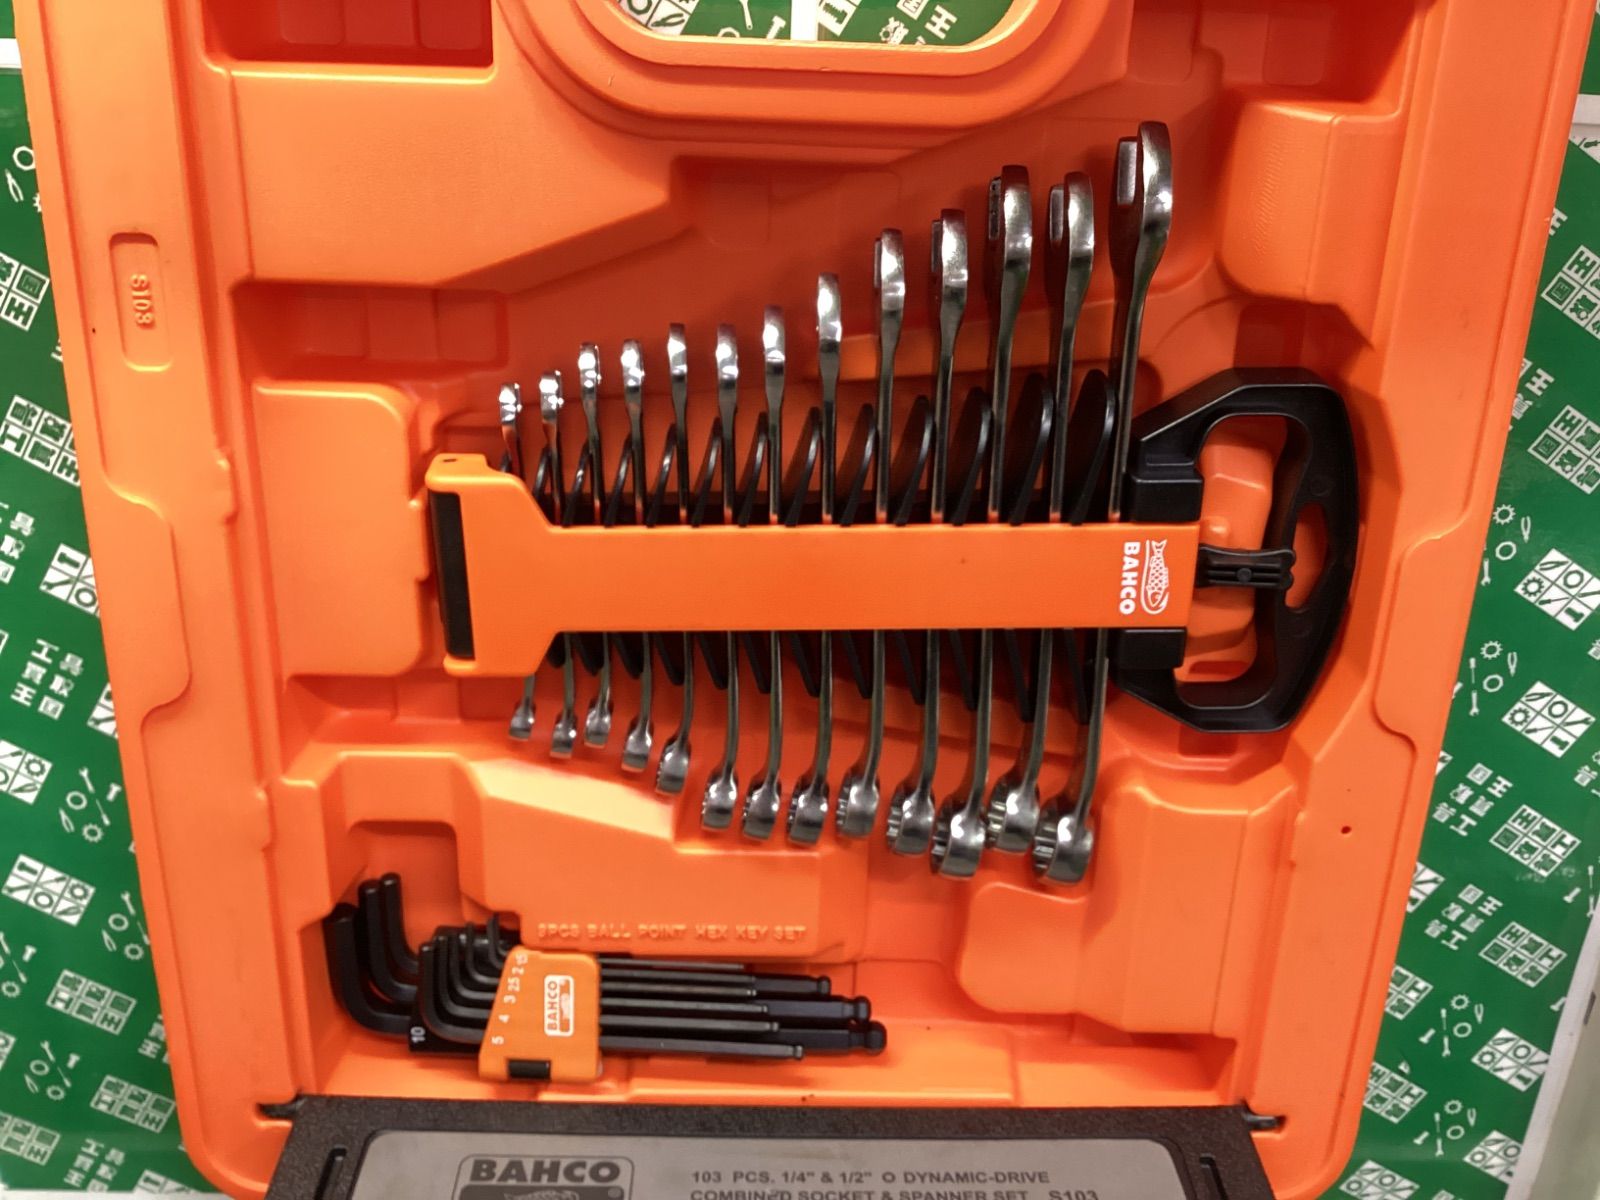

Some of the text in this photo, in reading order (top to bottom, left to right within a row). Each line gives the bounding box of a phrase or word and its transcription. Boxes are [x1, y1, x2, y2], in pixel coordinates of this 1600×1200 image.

[1119, 541, 1140, 615] BAHCO
[586, 923, 632, 940] BALL
[638, 923, 686, 940] POINT
[695, 924, 728, 940] HEX
[735, 924, 768, 941] KEY
[774, 925, 806, 941] SET
[503, 994, 516, 1004] 3
[547, 980, 558, 1031] BAHCO
[498, 1014, 510, 1024] 4
[410, 1026, 426, 1043] 10
[491, 1035, 504, 1045] 5
[470, 1159, 621, 1183] BAHCO
[693, 1170, 722, 1184] 103
[732, 1171, 775, 1184] PCS.
[781, 1171, 815, 1184] 1/4"
[820, 1172, 834, 1184] &
[839, 1171, 872, 1184] 1/2"
[903, 1171, 1050, 1184] DYNAMIC-DRIVE
[797, 1190, 875, 1200] SOCKET
[880, 1190, 895, 1200] &
[899, 1190, 988, 1200] SPANNER
[993, 1190, 1028, 1200] SET
[1048, 1189, 1099, 1200] S103
